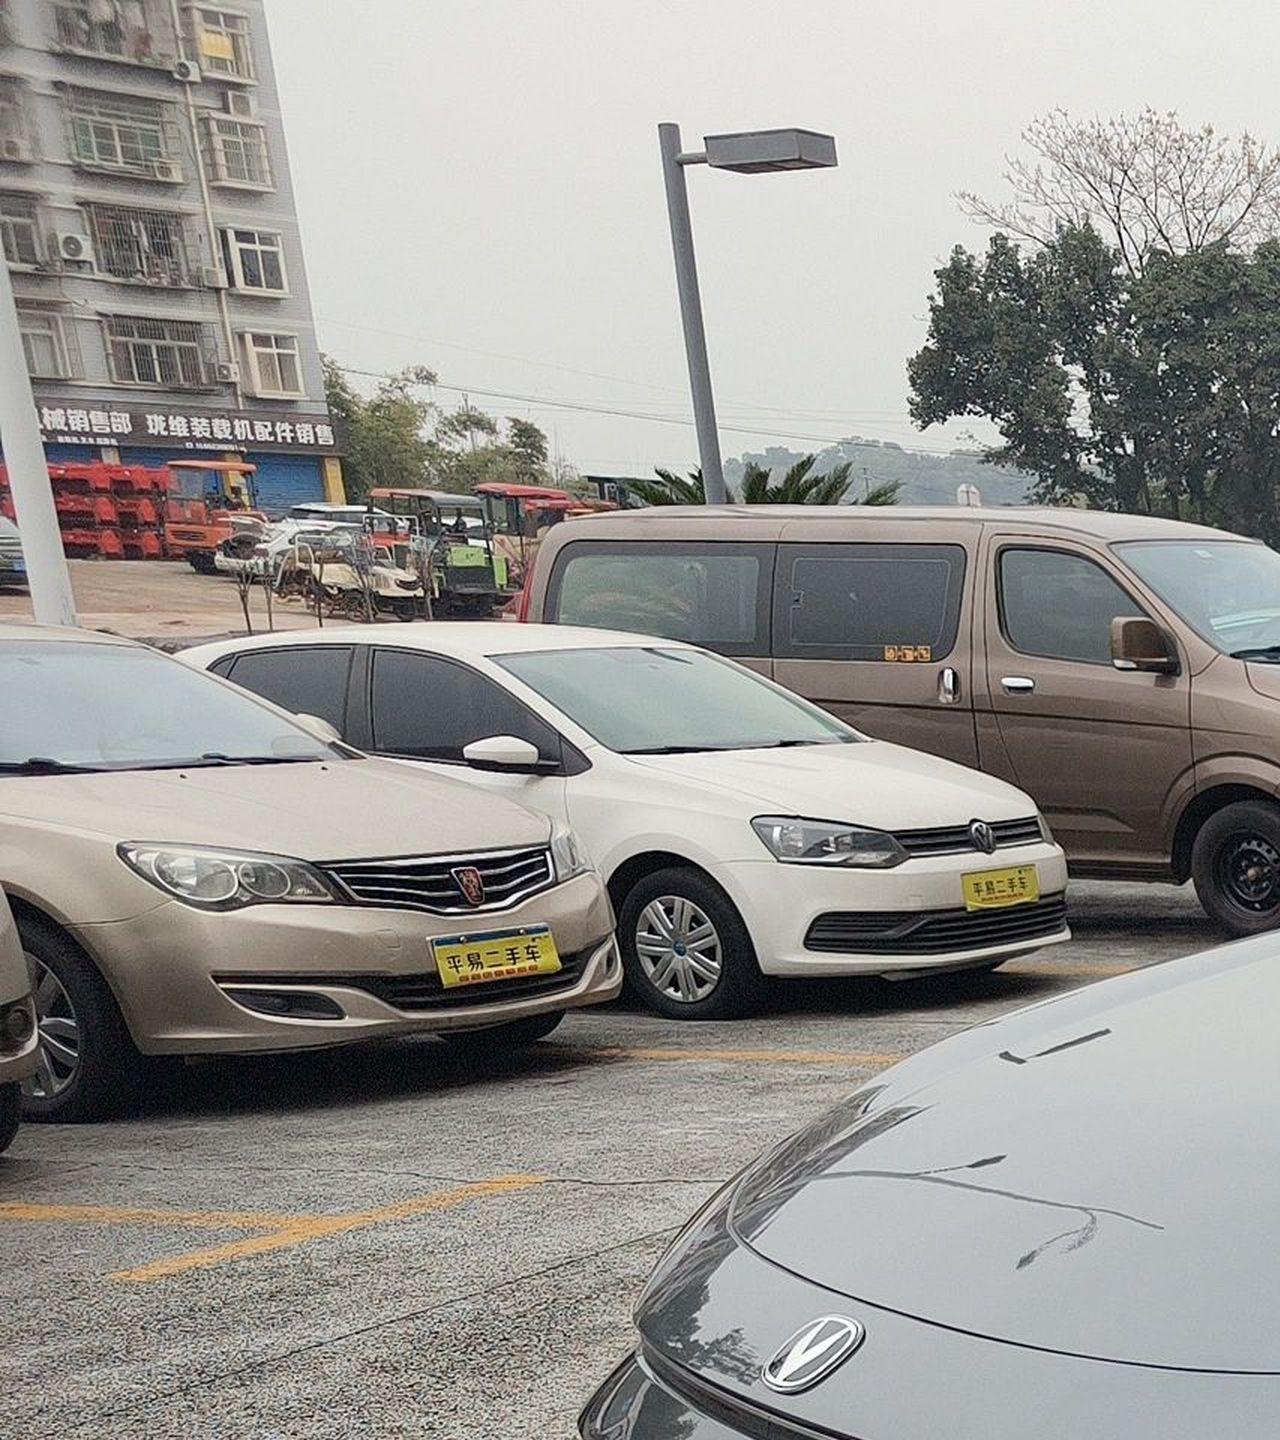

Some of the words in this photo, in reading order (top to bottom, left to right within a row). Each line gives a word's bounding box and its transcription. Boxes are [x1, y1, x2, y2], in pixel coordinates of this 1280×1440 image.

[40, 407, 132, 434] 械销售部
[446, 944, 542, 974] 平易二手车
